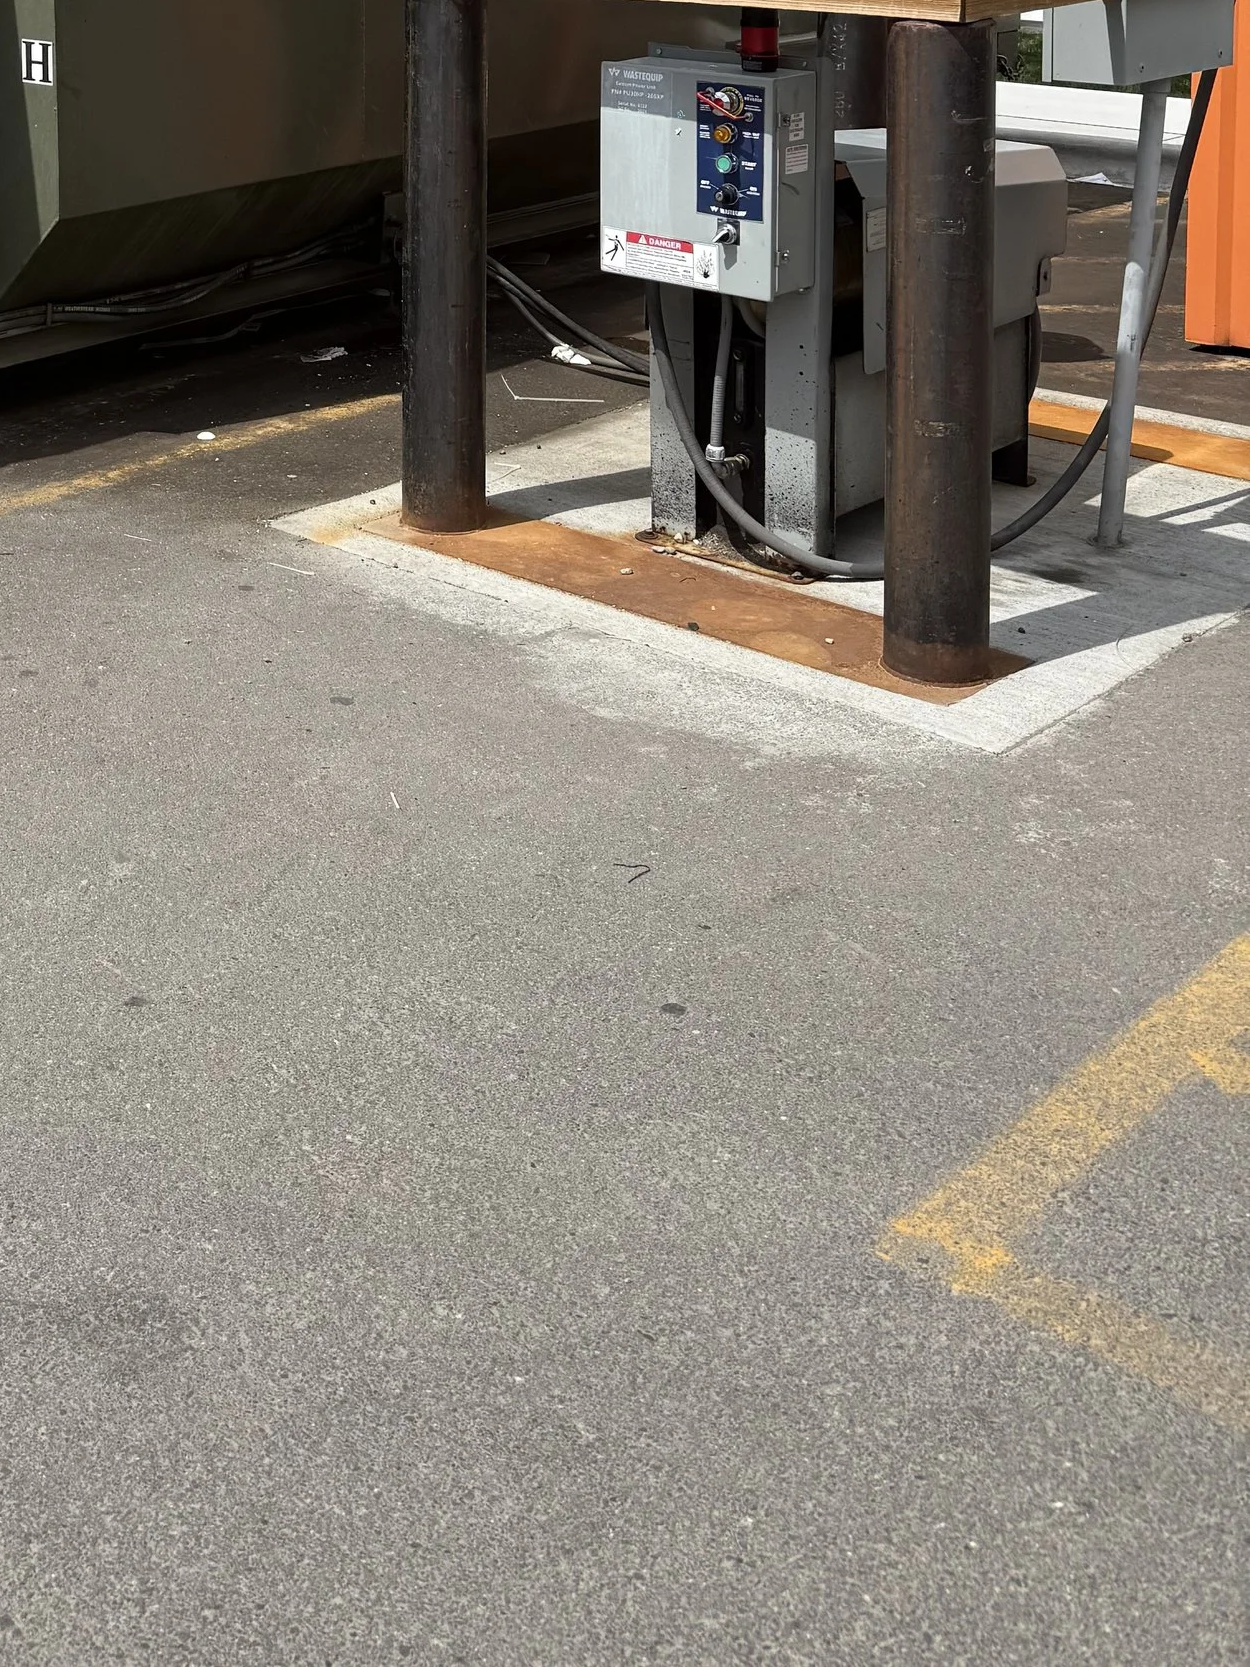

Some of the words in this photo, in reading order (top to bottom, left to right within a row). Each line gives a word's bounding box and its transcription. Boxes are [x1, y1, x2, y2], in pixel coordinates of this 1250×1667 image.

[22, 41, 52, 83] H
[623, 70, 664, 82] WASTEQUIP
[649, 238, 681, 250] DANGER
